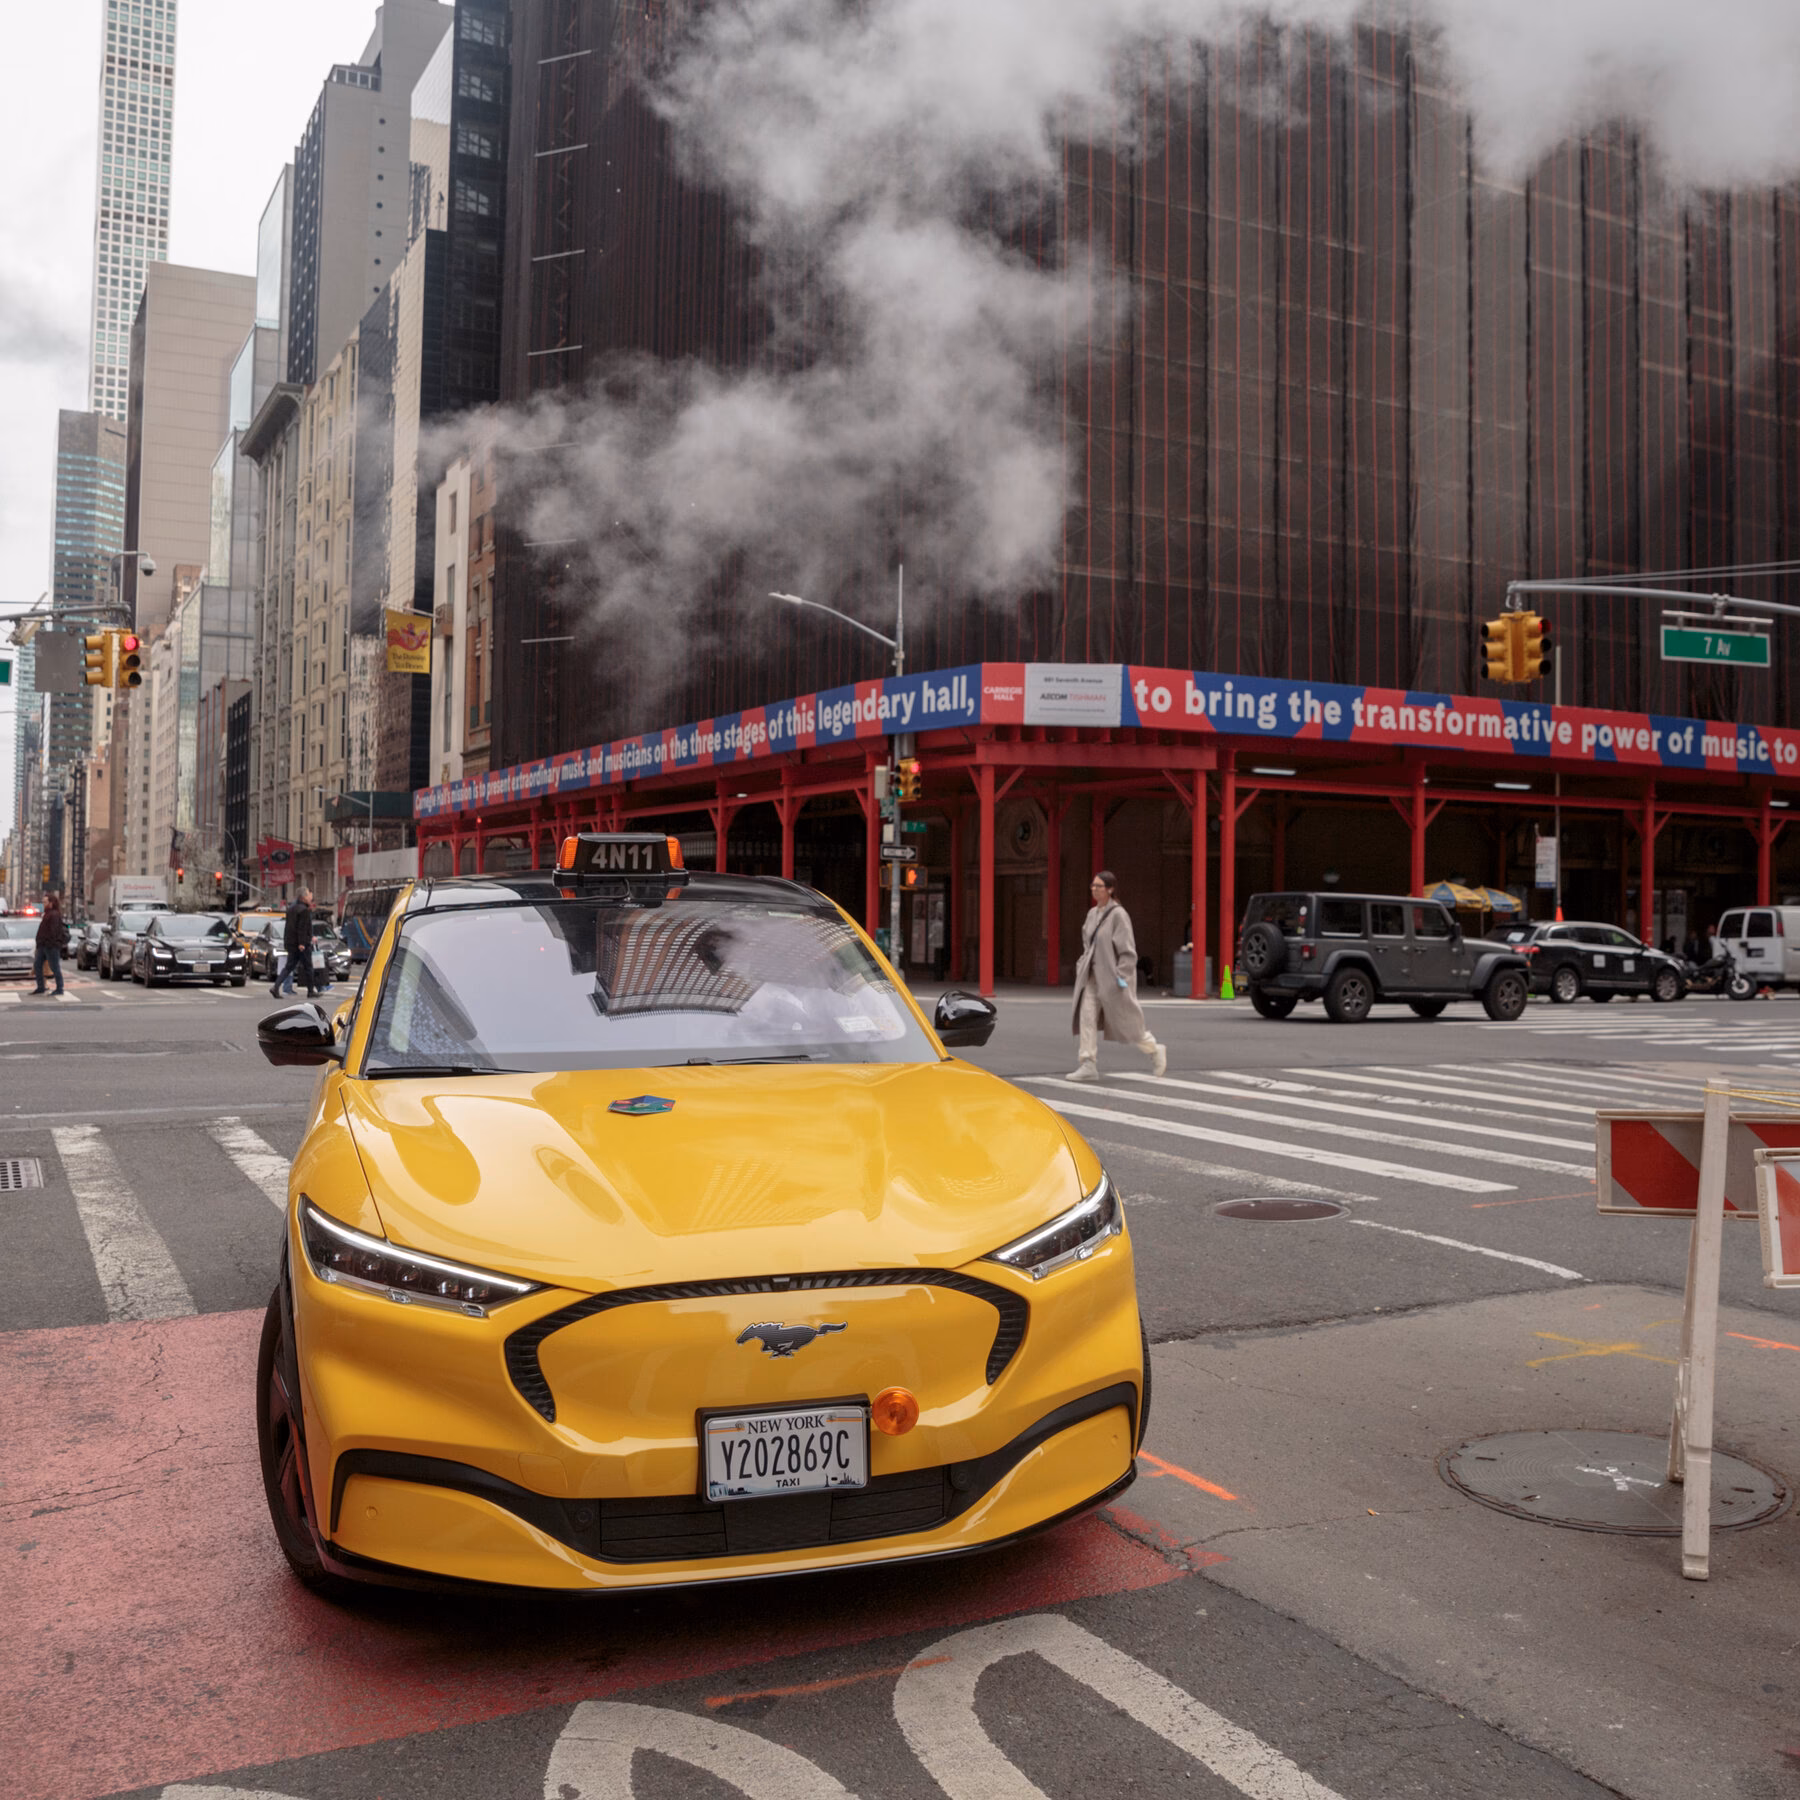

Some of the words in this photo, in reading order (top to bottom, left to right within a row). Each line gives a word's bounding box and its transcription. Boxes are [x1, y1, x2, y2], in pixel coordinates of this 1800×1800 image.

[1704, 636, 1712, 655] 7
[1716, 638, 1731, 656] Av
[983, 686, 1023, 695] CARNEGIE
[1134, 679, 1172, 713] to
[1185, 679, 1278, 730] bring
[1288, 689, 1342, 725] the
[1351, 697, 1573, 744] transformative
[1581, 722, 1662, 753] power
[1667, 726, 1694, 755] of
[1701, 730, 1769, 762] music
[1773, 737, 1798, 764] to
[451, 782, 472, 803] mission
[472, 780, 479, 799] is
[479, 781, 486, 798] to
[486, 775, 510, 802] present
[511, 762, 560, 792] extraordinary
[561, 755, 585, 781] music
[586, 751, 603, 776] and
[605, 742, 653, 773] musicians
[654, 742, 668, 764] on
[670, 734, 688, 760] the
[690, 728, 722, 757] three
[724, 720, 766, 755] stages
[768, 709, 784, 741] of
[786, 702, 816, 737] this
[818, 687, 917, 737] legendary
[922, 674, 975, 717] hall,
[591, 843, 654, 870] 4N11
[748, 1420, 780, 1434] NEW
[785, 1414, 825, 1430] YORK
[721, 1430, 850, 1481] Y202869C
[775, 1478, 800, 1488] TAXI
